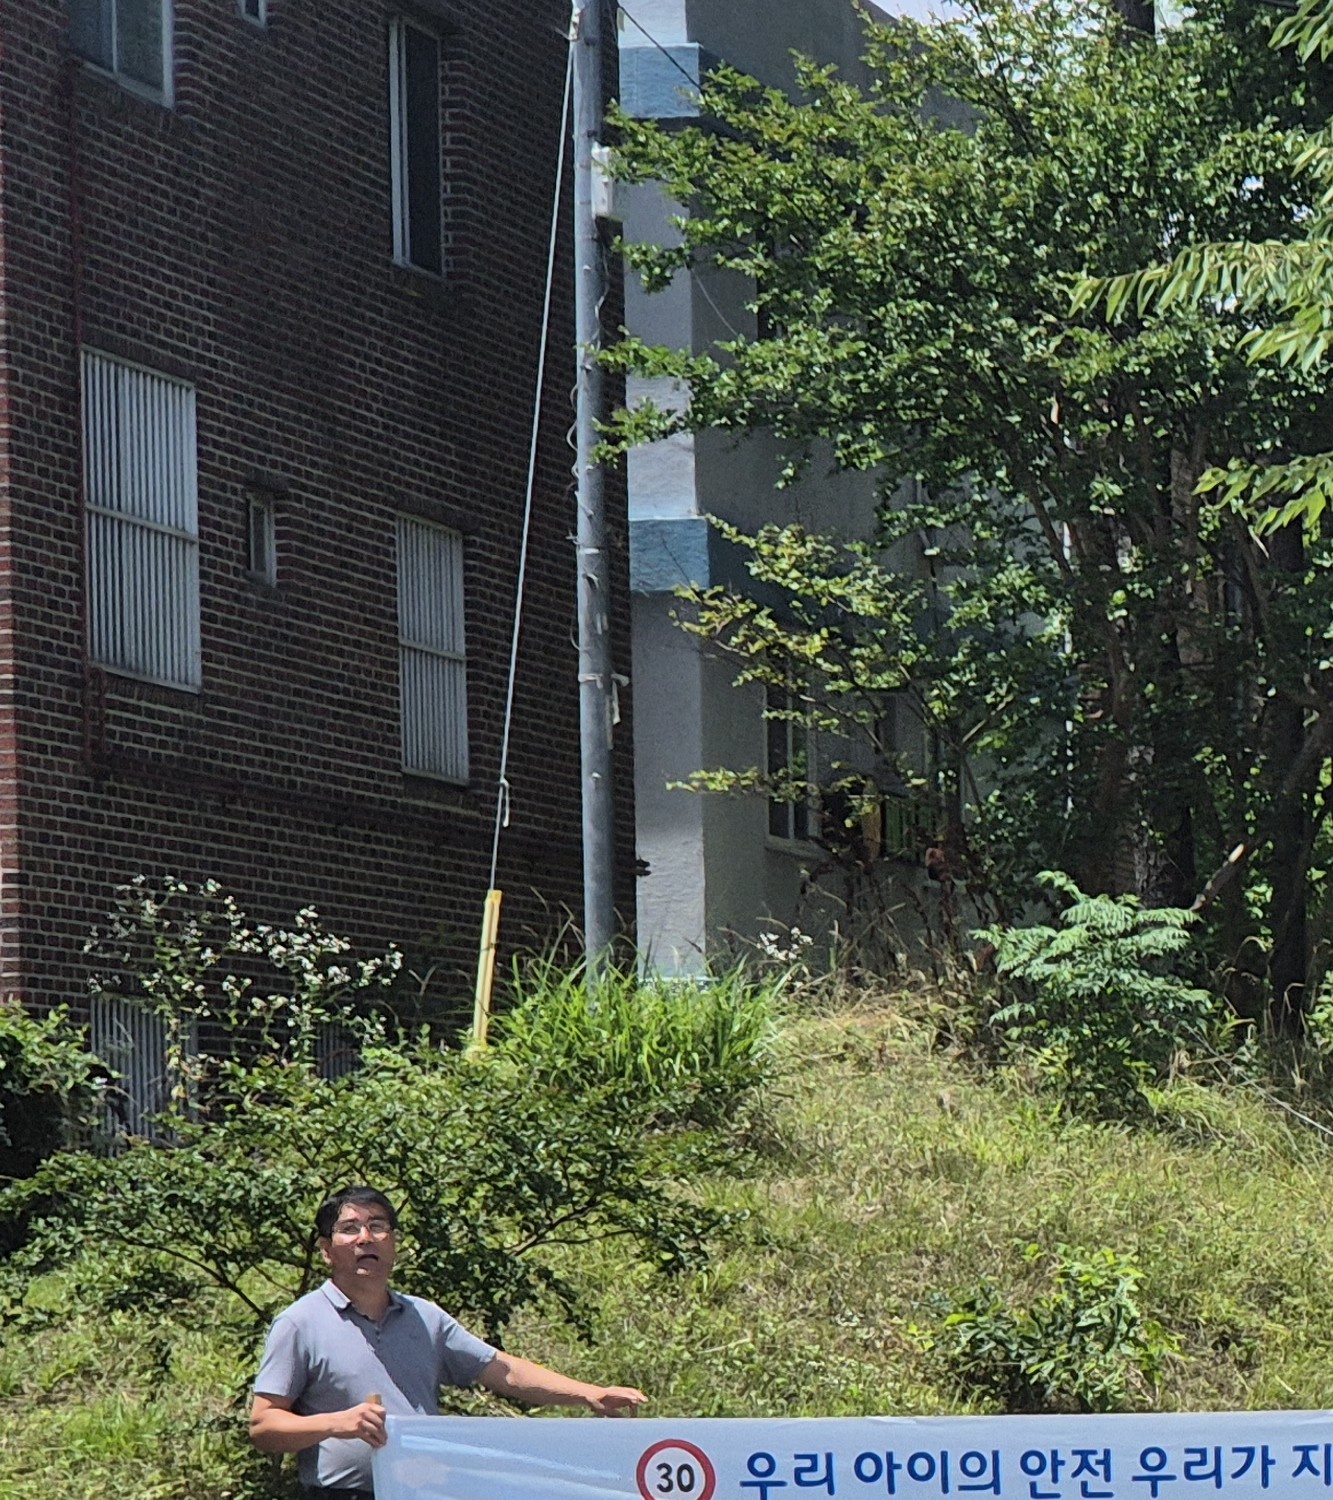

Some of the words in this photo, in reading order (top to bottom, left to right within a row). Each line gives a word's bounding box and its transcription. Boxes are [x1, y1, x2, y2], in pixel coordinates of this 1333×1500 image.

[655, 1462, 695, 1493] 30
[853, 1447, 1001, 1498] 아이의
[1019, 1447, 1114, 1500] 안전
[1131, 1444, 1276, 1500] 우리가
